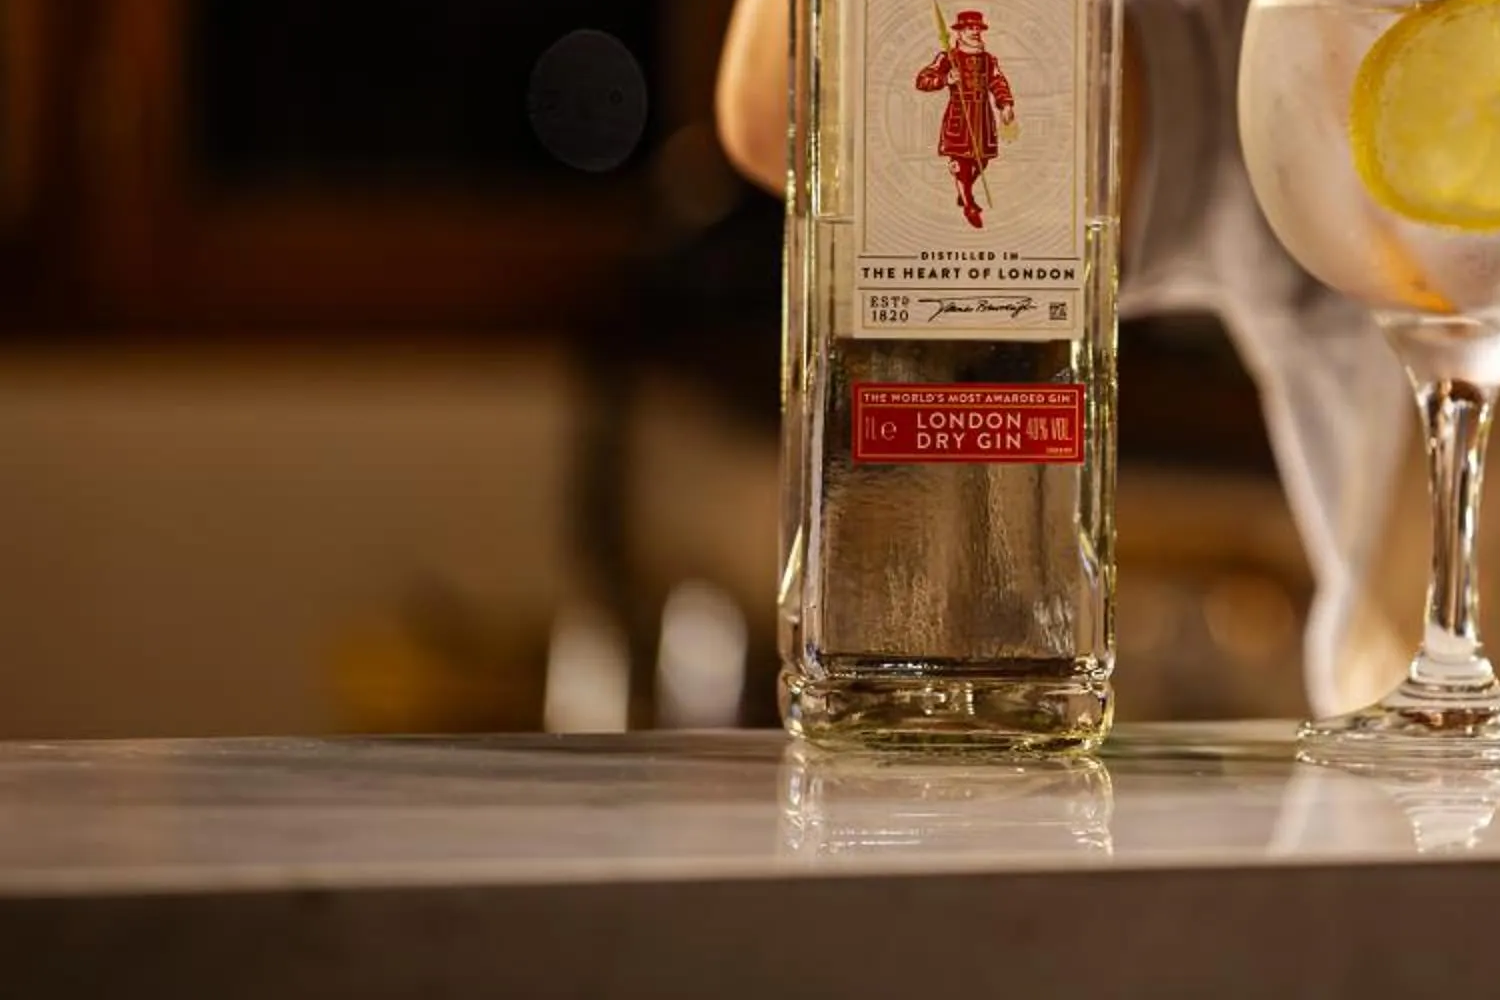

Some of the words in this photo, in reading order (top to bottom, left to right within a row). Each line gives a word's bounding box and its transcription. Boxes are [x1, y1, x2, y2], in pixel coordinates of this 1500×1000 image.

[921, 251, 996, 262] DISTILLED
[1003, 252, 1019, 262] IN
[862, 267, 896, 280] THE
[903, 267, 962, 280] HEART
[968, 268, 991, 280] OF
[998, 268, 1075, 280] LONDON
[872, 310, 909, 323] 1820
[864, 393, 887, 403] THE
[891, 393, 945, 404] WORLD'S
[948, 393, 982, 404] MOST
[985, 393, 1045, 404] AWARDED
[1048, 393, 1072, 404] GIN
[917, 412, 1021, 430] LONDON
[917, 433, 965, 450] DRY
[977, 433, 1021, 450] GIN
